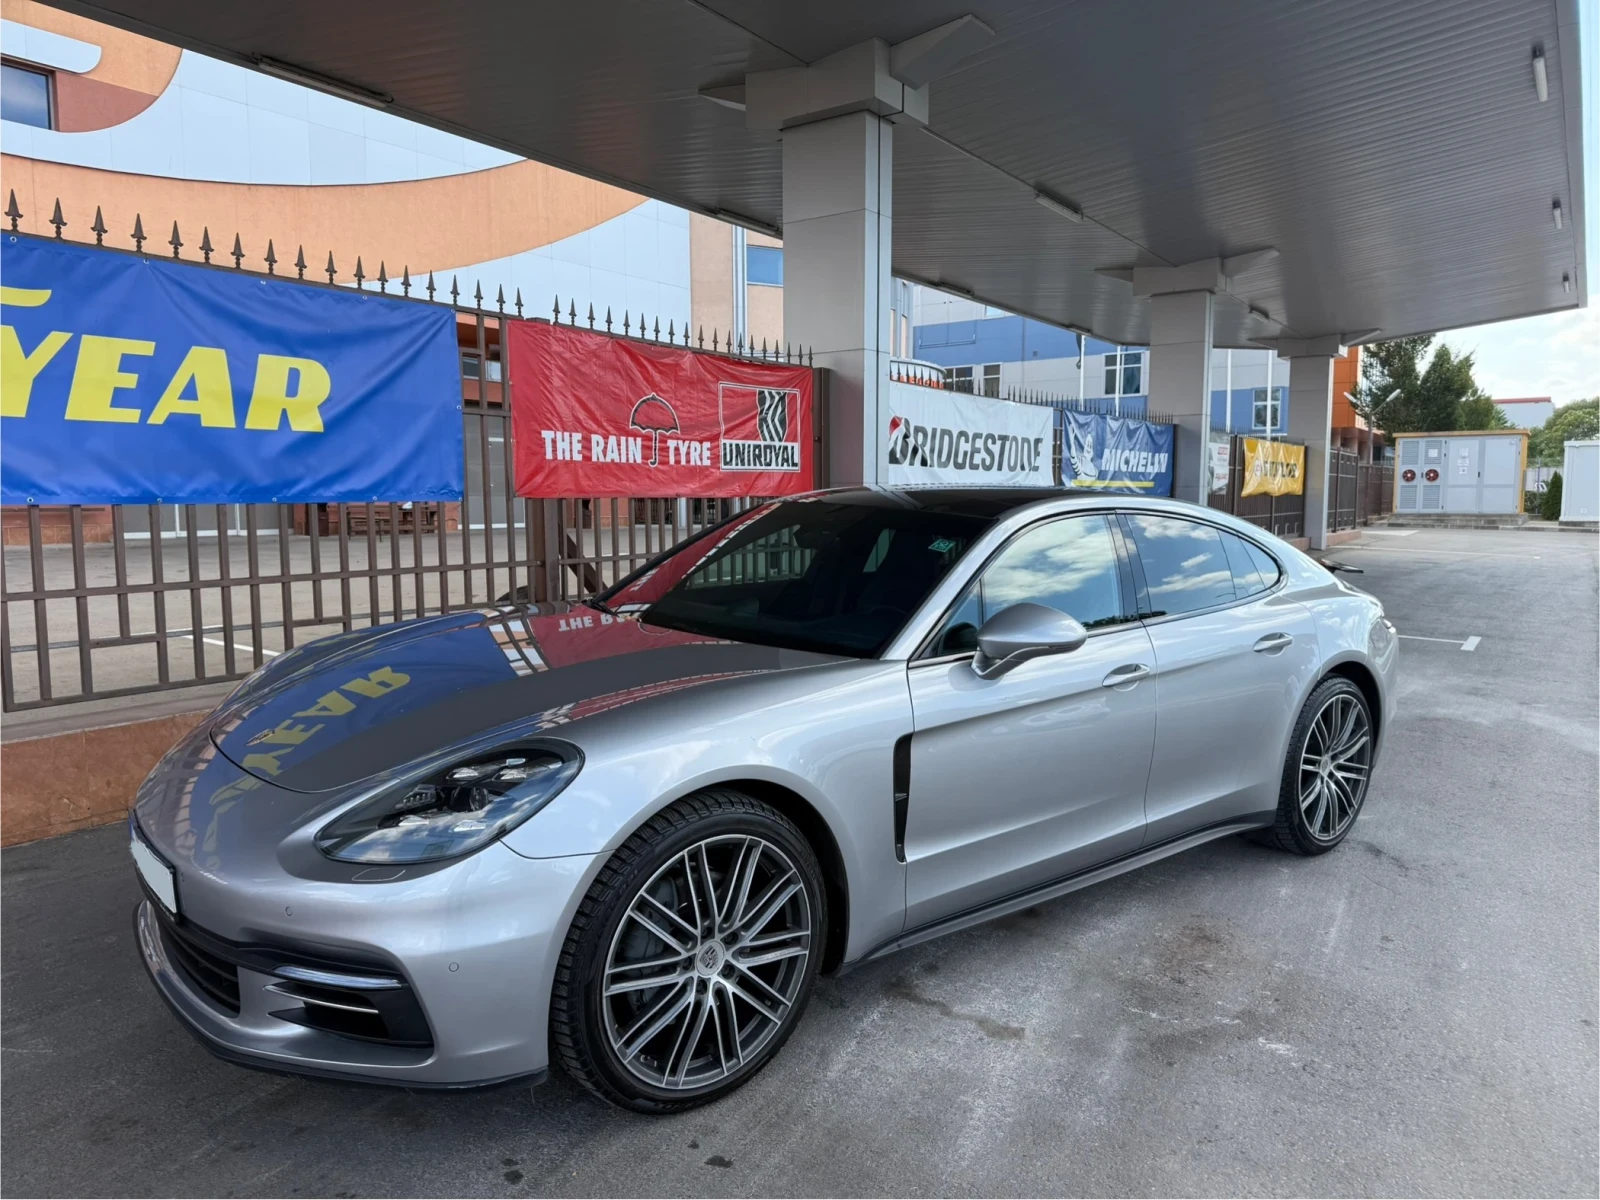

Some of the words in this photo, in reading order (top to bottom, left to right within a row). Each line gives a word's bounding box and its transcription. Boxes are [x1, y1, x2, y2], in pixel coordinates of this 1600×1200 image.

[0, 325, 331, 432] YEAR
[541, 430, 582, 461] THE
[591, 434, 642, 464] RAIN
[667, 440, 711, 466] TYRE
[722, 442, 799, 468] UNIROYAL
[889, 415, 1043, 472] BRIDGESTONE
[1101, 448, 1168, 473] MICHELIN
